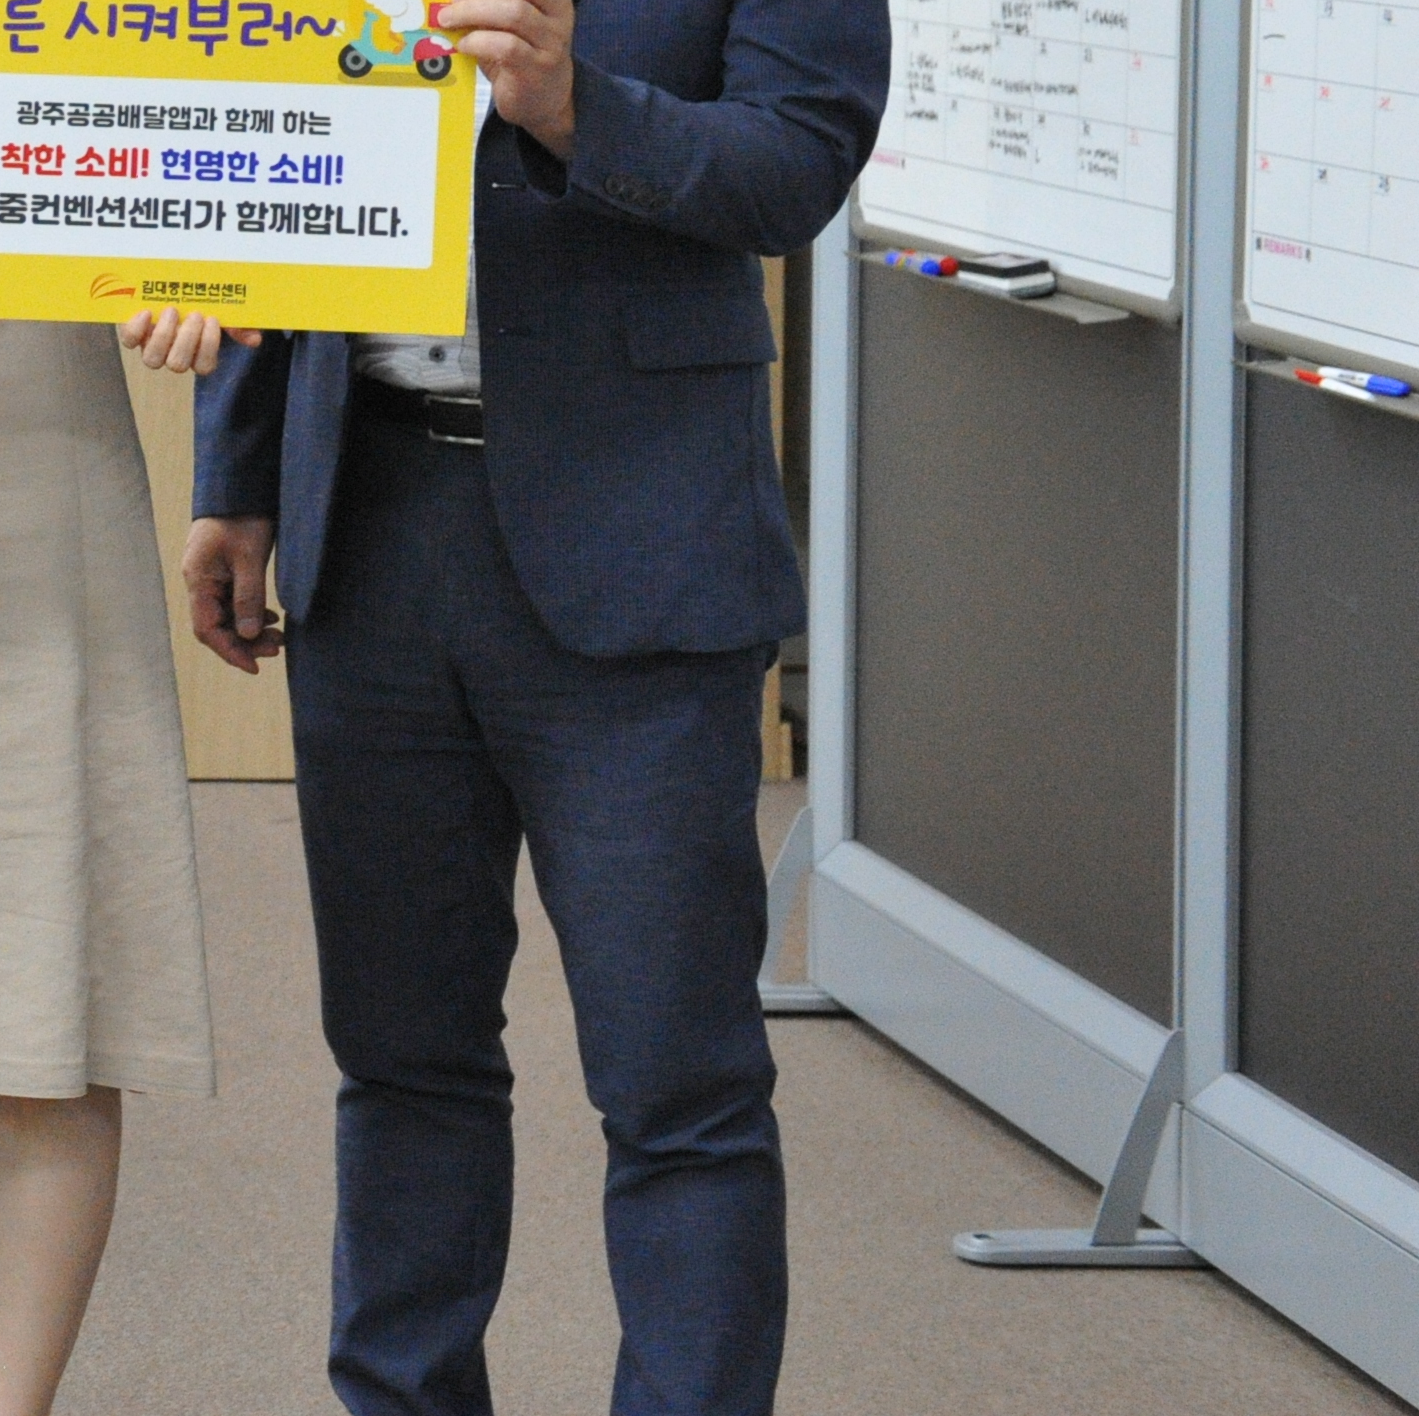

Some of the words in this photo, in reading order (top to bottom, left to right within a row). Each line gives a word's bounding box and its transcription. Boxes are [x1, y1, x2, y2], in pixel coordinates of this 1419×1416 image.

[17, 100, 217, 132] 광주공공배달앱과
[225, 109, 275, 134] 함께
[283, 110, 331, 135] 하는
[1, 142, 65, 176] 착한
[75, 146, 149, 178] 소비!
[161, 148, 259, 183] 현명한
[269, 153, 343, 185] 소비!
[237, 202, 409, 238] 함께합니다.
[142, 281, 246, 297] 김대중컨벤션센터
